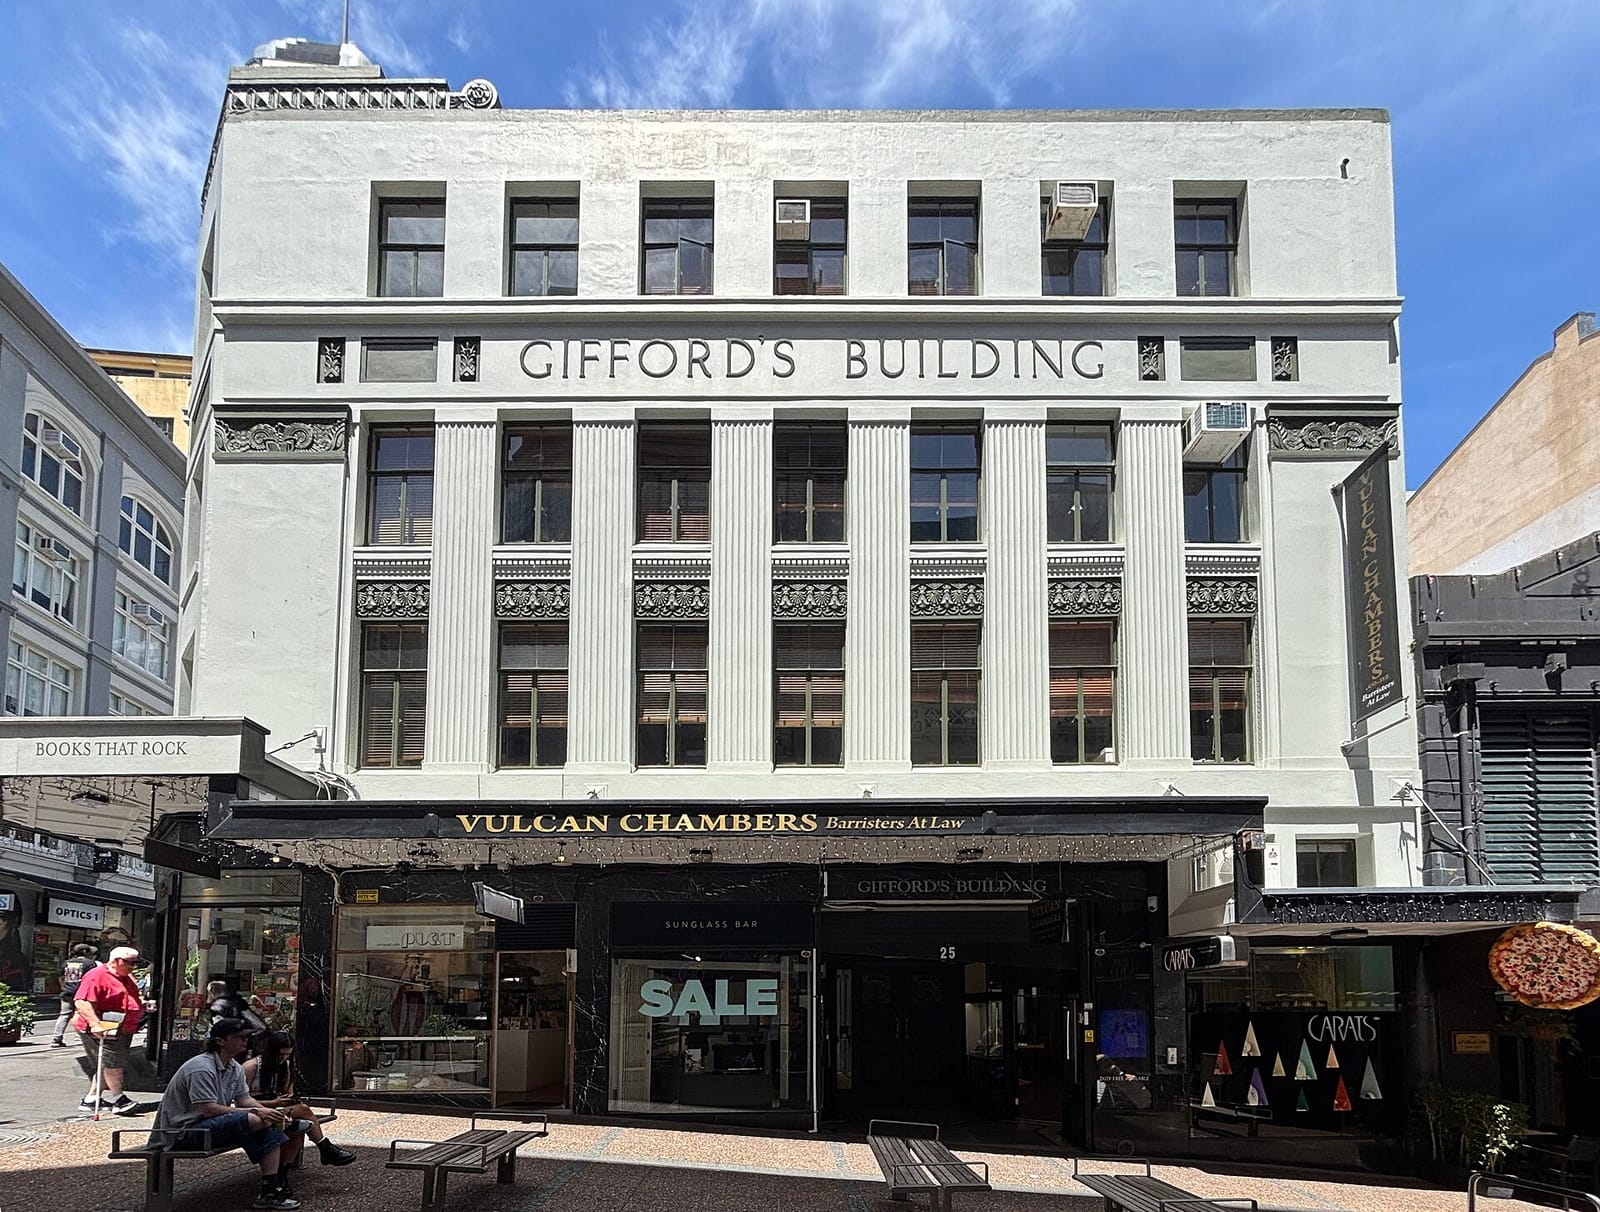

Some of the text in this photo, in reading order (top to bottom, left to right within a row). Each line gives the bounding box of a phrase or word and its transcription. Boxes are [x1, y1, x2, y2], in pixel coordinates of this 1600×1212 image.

[519, 335, 1104, 379] GIFFORD'S BUILDING
[1358, 465, 1384, 680] VULCAN CHAMBERS
[1362, 680, 1395, 702] Barristers
[1376, 691, 1391, 702] Law
[35, 741, 187, 757] BOOKS THAT ROCK
[456, 813, 965, 833] VULCAN CHAMBERS Barristers At Law
[857, 879, 1048, 893] GIFFORD'S BUILDING
[55, 907, 99, 921] OPTICS 1
[664, 920, 759, 929] SUNGLASS BAR
[939, 946, 956, 960] 25
[1164, 948, 1196, 971] CARATS
[638, 978, 779, 1019] SALE
[1308, 1014, 1377, 1042] CARATS
